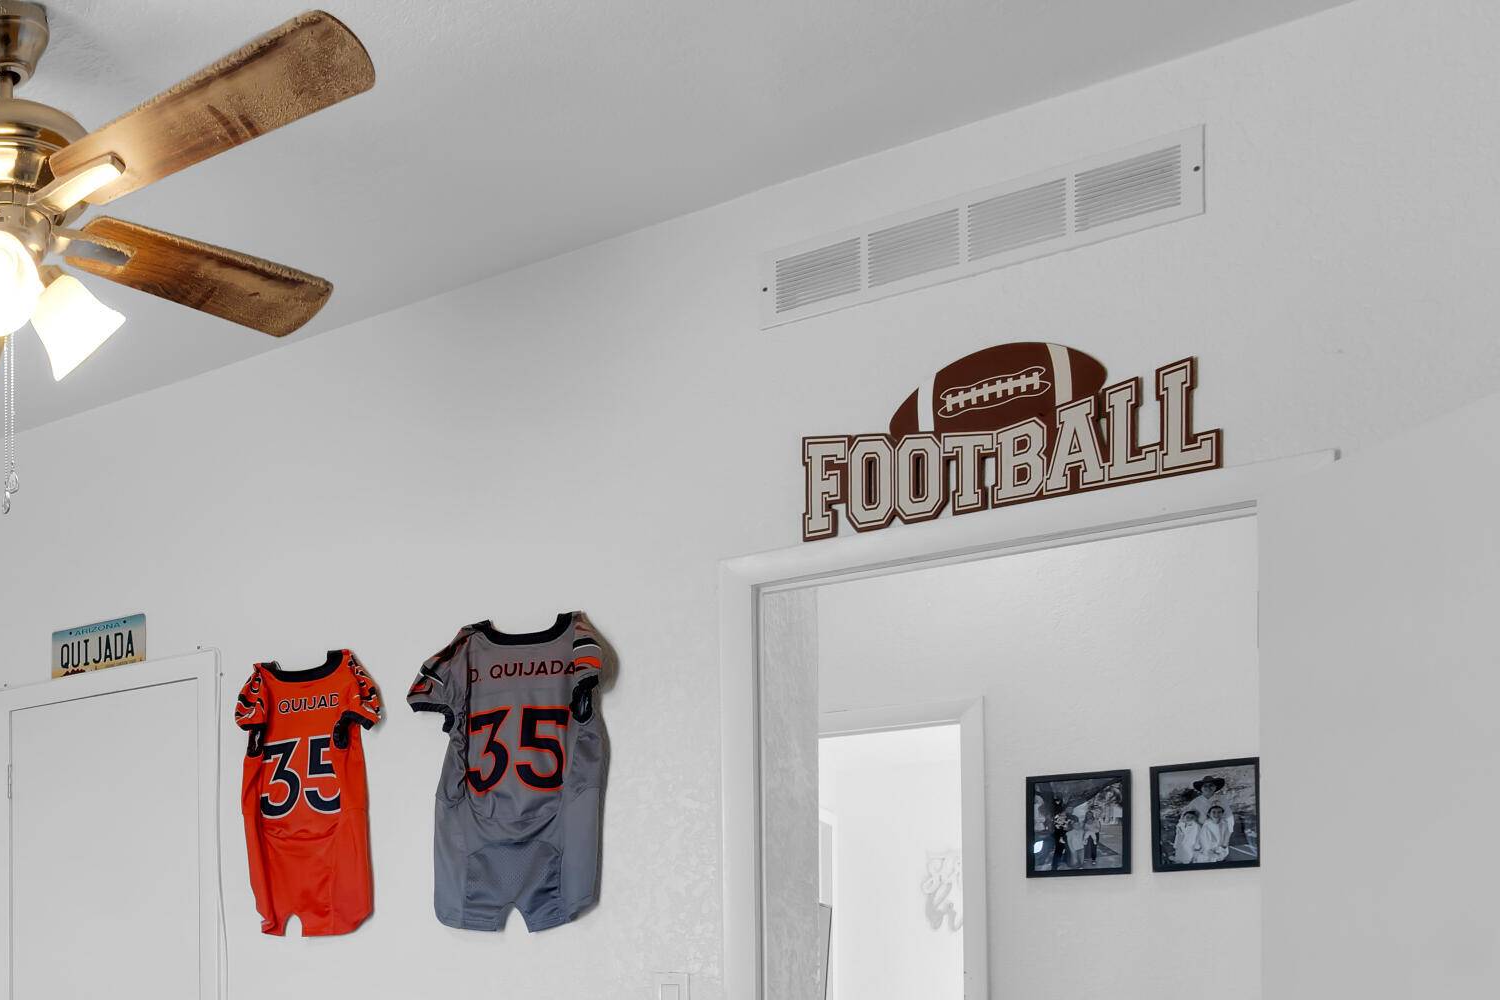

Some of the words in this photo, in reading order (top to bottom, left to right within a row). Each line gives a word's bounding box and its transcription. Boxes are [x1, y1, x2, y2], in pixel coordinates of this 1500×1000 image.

[802, 356, 1224, 543] FOOTBALL
[60, 629, 135, 669] QUIJADA
[74, 622, 120, 637] ARIZONA
[489, 660, 576, 680] QUIJADA
[260, 733, 342, 820] 35
[465, 704, 571, 796] 35
